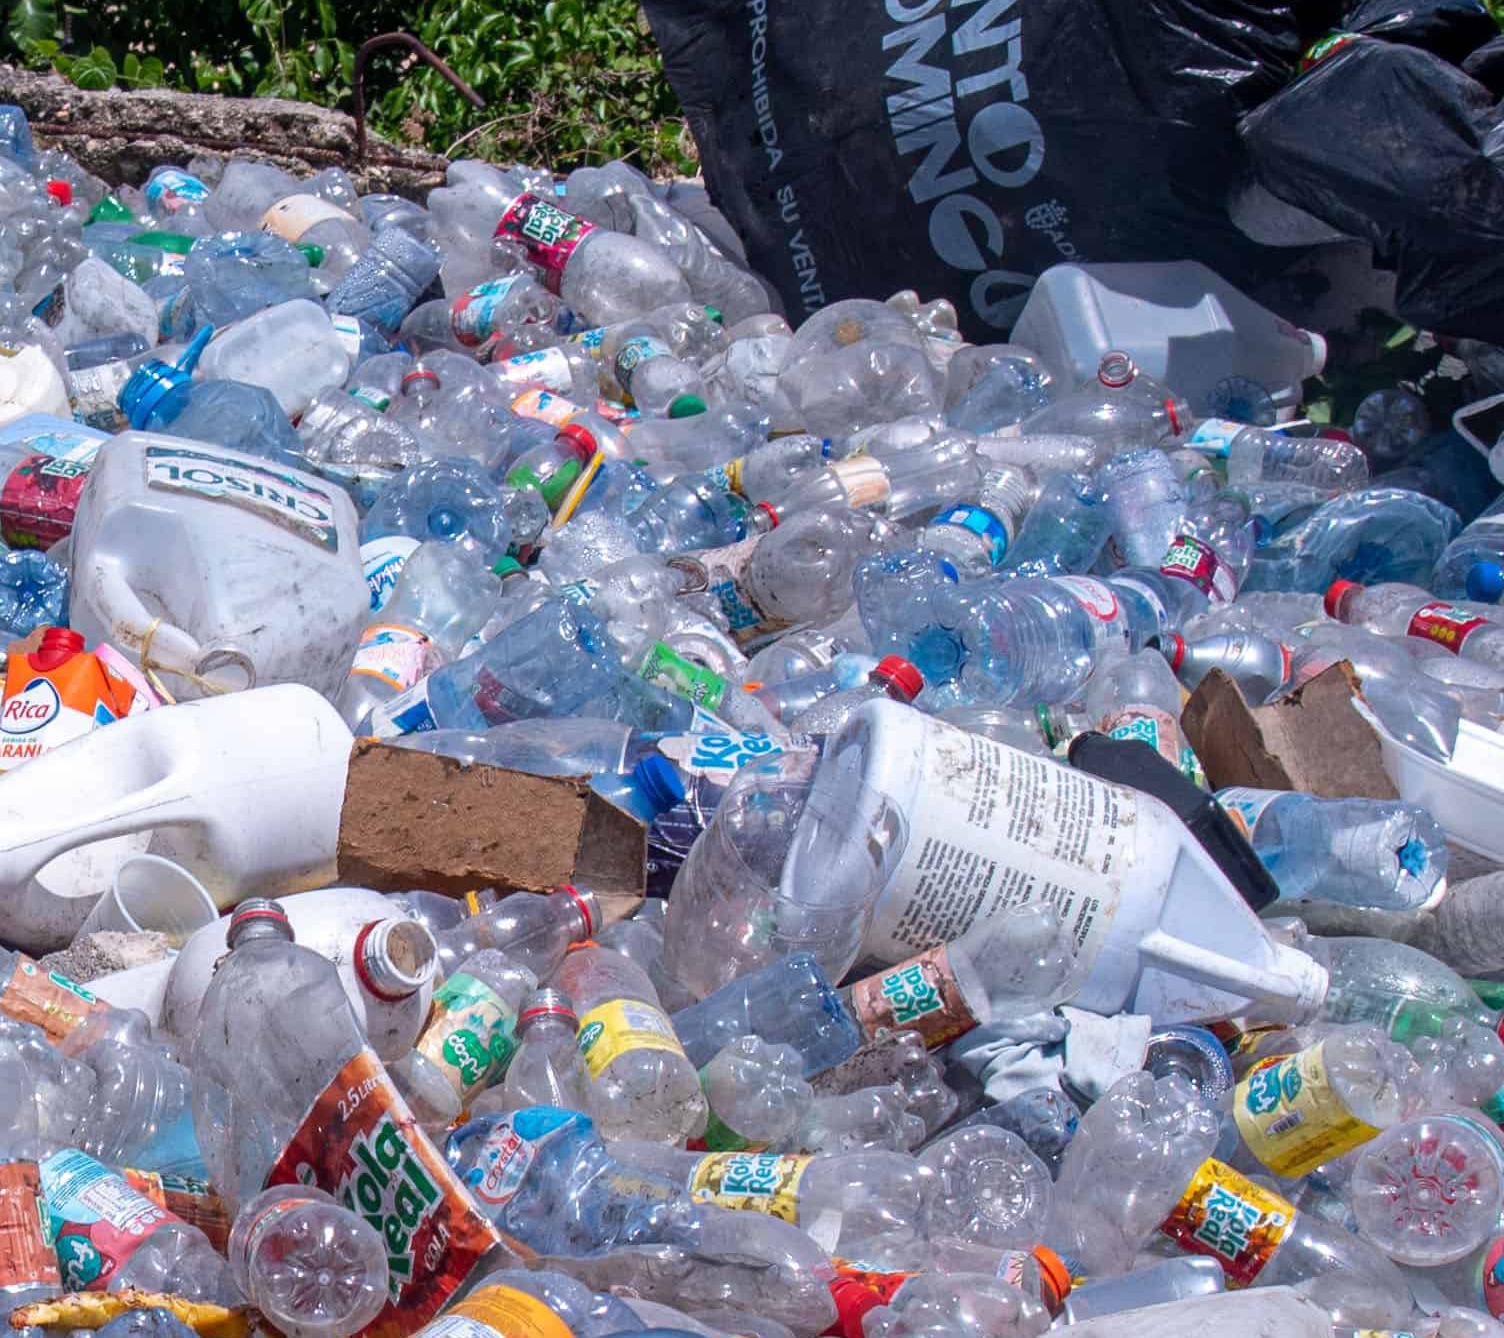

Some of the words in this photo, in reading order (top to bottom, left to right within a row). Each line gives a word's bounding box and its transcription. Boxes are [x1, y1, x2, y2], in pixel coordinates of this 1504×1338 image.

[775, 185, 797, 226] SU
[153, 463, 329, 523] CRISOL
[4, 699, 50, 719] Rica
[882, 973, 915, 1024] Kola
[903, 963, 944, 1013] Real
[336, 1085, 363, 1121] 2.5
[724, 1154, 752, 1194] Kola
[749, 1152, 784, 1195] Real
[1195, 1185, 1237, 1250] Real
[1218, 1198, 1260, 1260] Kola
[422, 1222, 450, 1274] COLA
